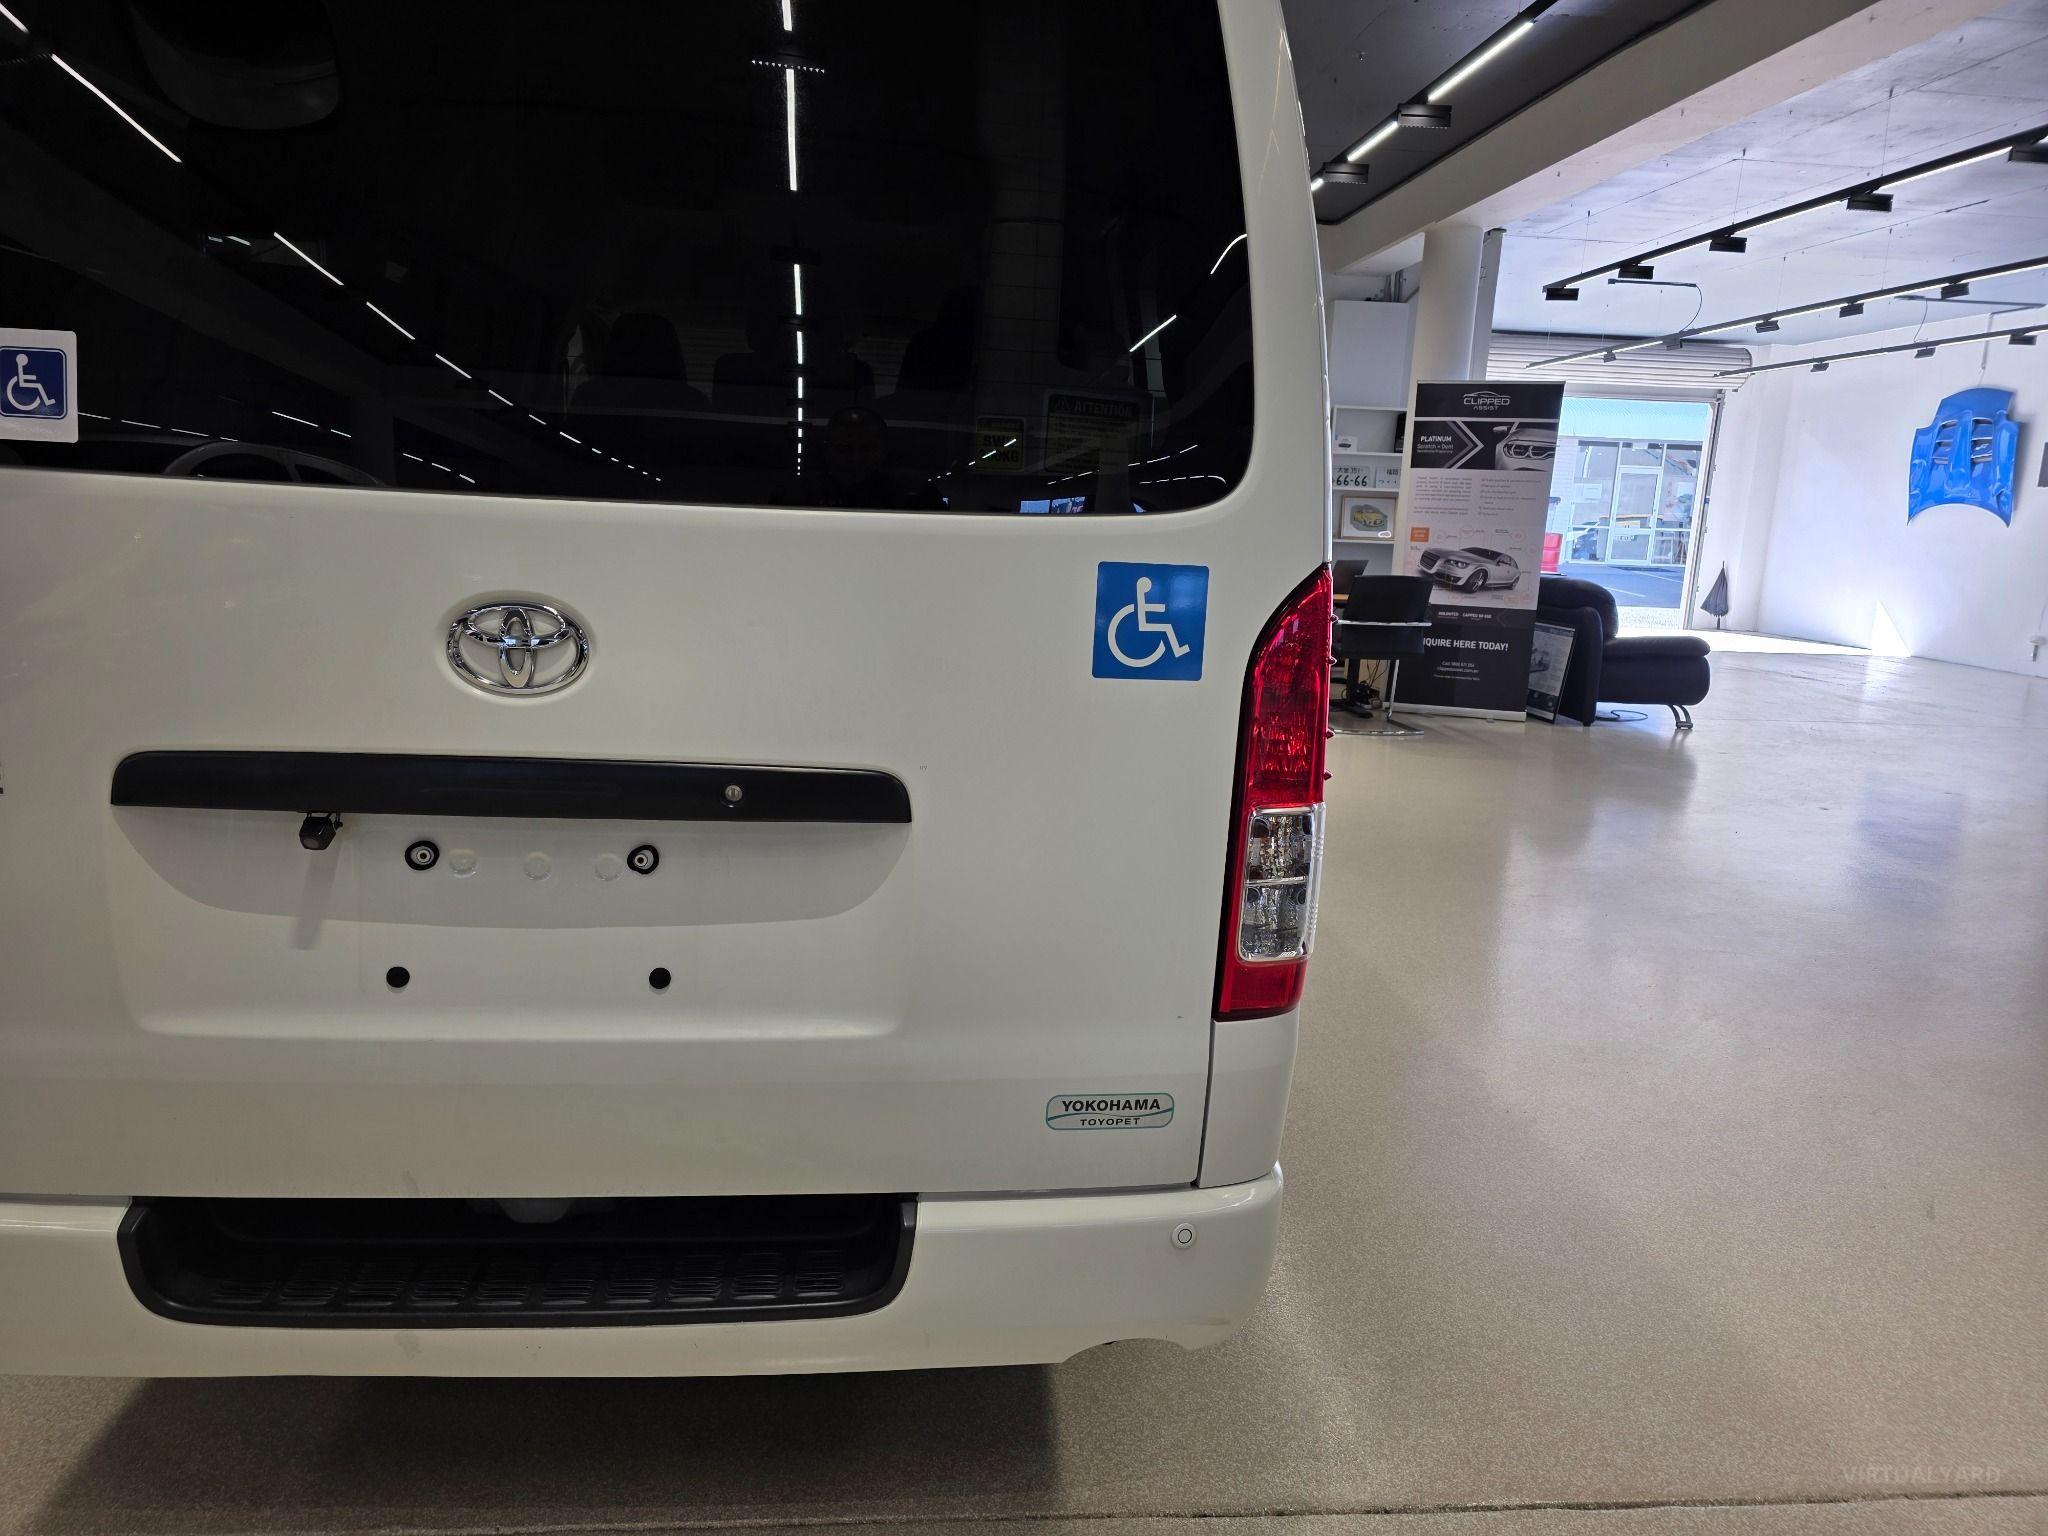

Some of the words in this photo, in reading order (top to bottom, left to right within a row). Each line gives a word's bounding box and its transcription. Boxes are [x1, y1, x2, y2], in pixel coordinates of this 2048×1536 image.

[1463, 397, 1510, 406] CLIPPED
[1423, 637, 1452, 648] QUIRE
[1453, 639, 1477, 649] HERE
[1478, 641, 1509, 652] TODAY!
[1062, 1098, 1161, 1112] YOKOHAMA
[1080, 1117, 1141, 1126] TOYOPET
